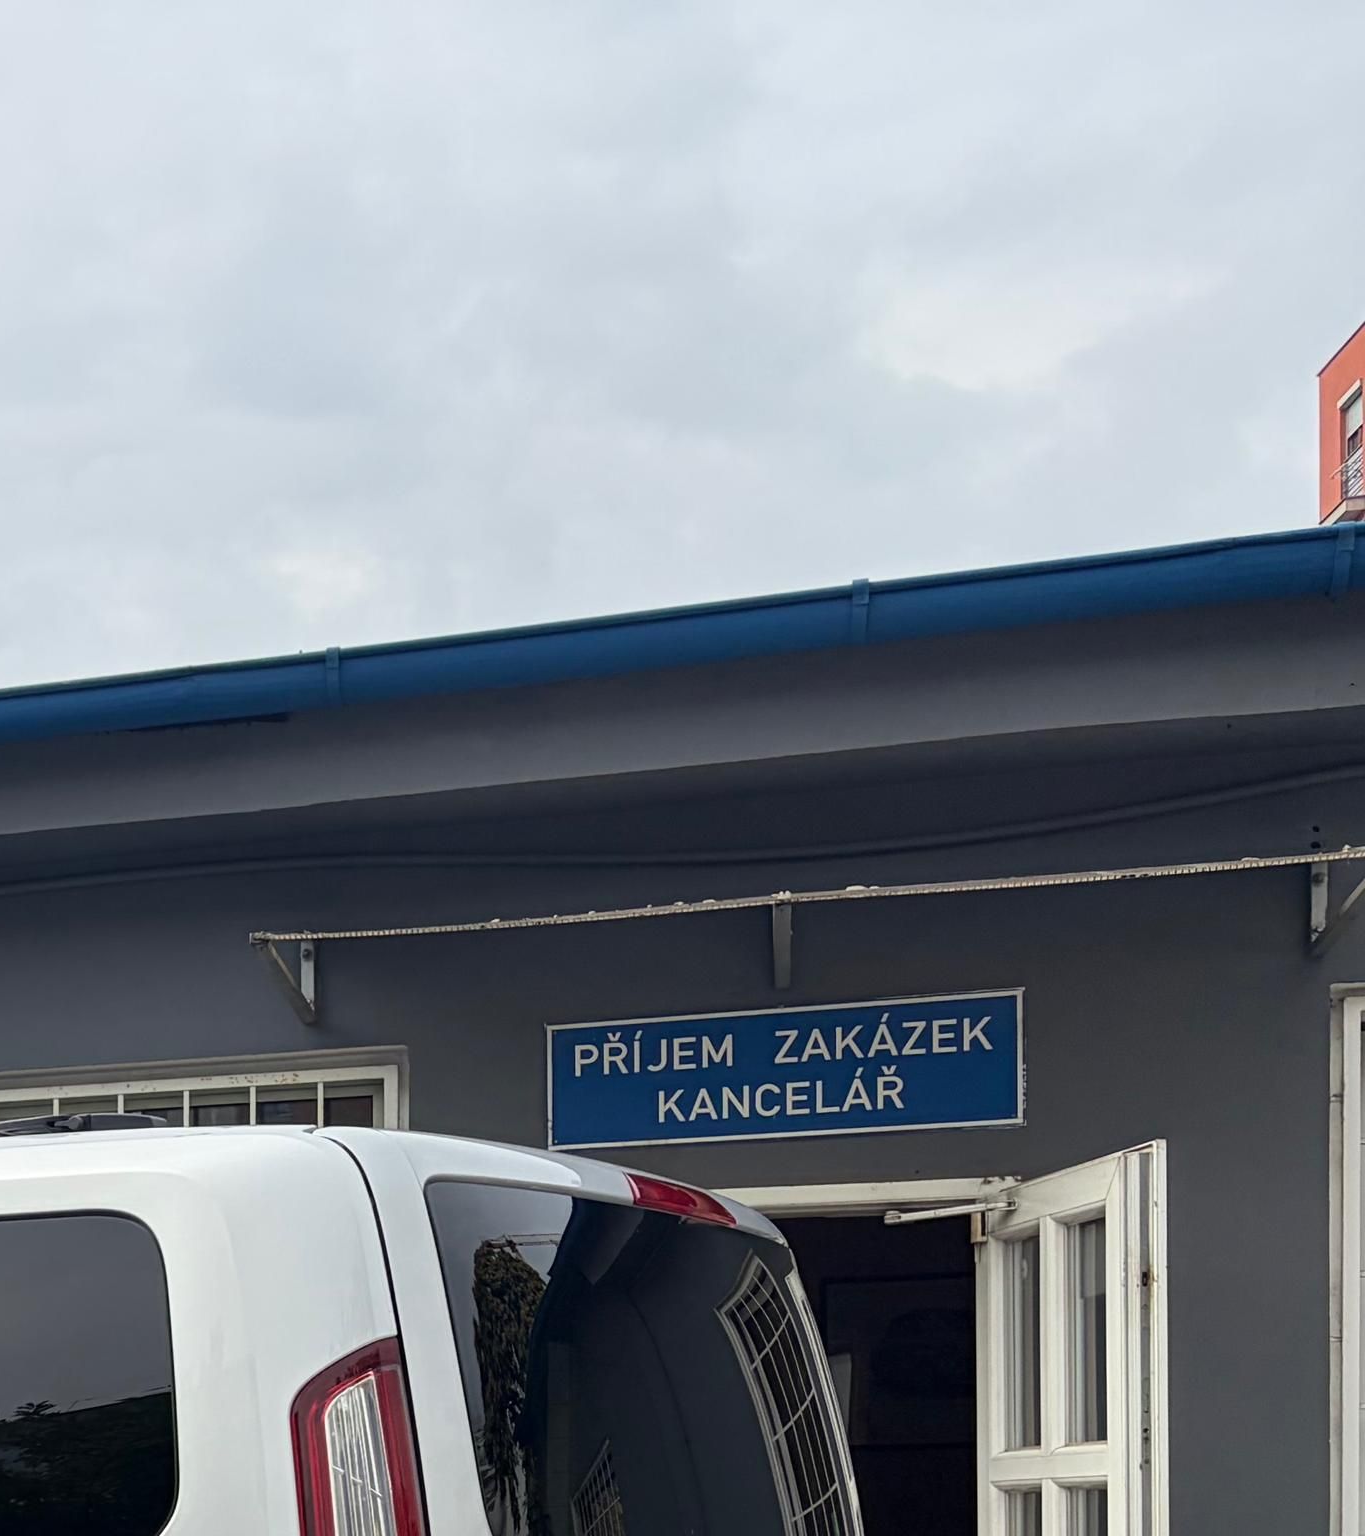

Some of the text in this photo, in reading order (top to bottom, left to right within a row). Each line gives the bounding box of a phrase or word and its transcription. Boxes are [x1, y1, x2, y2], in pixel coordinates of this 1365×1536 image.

[573, 1012, 994, 1078] PŘÍJEM ZAKÁZEK
[658, 1065, 906, 1124] KANCELÁŘ
